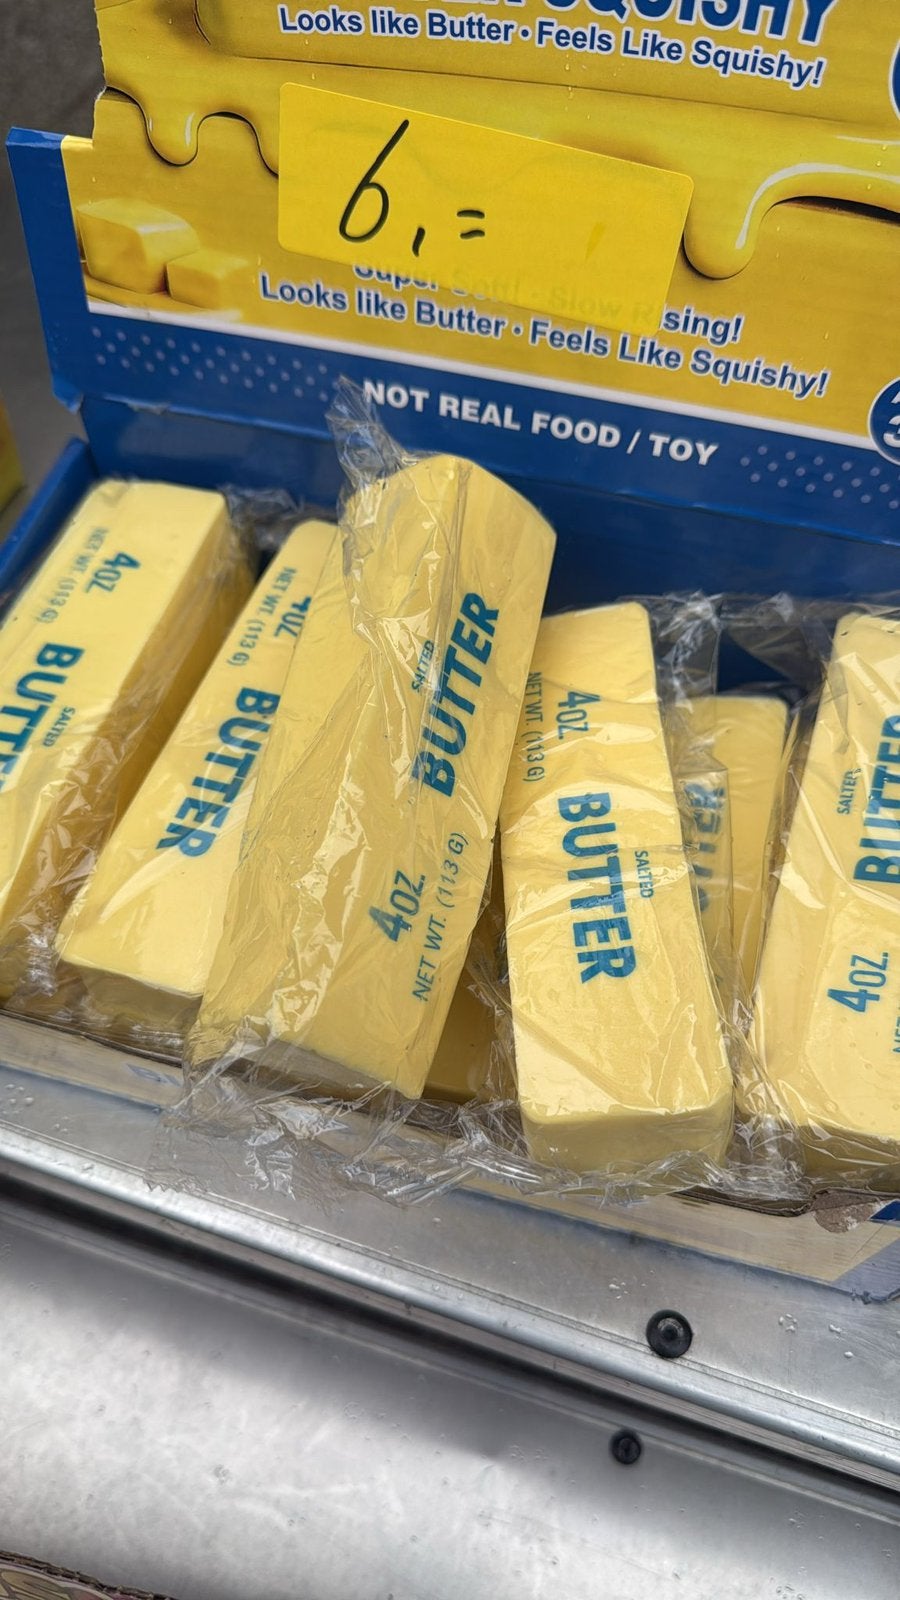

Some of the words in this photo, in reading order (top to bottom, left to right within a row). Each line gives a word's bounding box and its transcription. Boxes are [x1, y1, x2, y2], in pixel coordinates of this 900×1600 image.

[279, 8, 363, 33] Looks
[371, 10, 418, 36] like
[429, 13, 514, 42] Butter
[537, 21, 611, 52] Feels
[623, 30, 683, 61] Like
[692, 40, 824, 87] Squishy!
[261, 274, 347, 311] Looks
[357, 290, 405, 320] like
[416, 300, 505, 338] Butter
[531, 320, 608, 356] Feels
[619, 336, 681, 370] Like
[692, 350, 828, 398] Squishy!
[363, 381, 430, 412] NOT
[439, 394, 520, 430] REAL
[532, 412, 621, 448] FOOD
[649, 434, 719, 465] TOY
[273, 566, 297, 592] NET
[238, 618, 266, 650] (113
[227, 652, 251, 667] G)
[411, 592, 499, 798] BUTTER
[525, 671, 541, 699] NET
[42, 706, 76, 748] SALTED
[521, 730, 544, 762] (113
[155, 686, 281, 858] BUTTER
[522, 766, 545, 783] G)
[447, 832, 470, 856] G)
[436, 859, 460, 909] (113
[557, 791, 636, 984] BUTTER
[634, 849, 655, 899] SALTED
[423, 913, 448, 951] WT.
[412, 954, 437, 1001] NET
